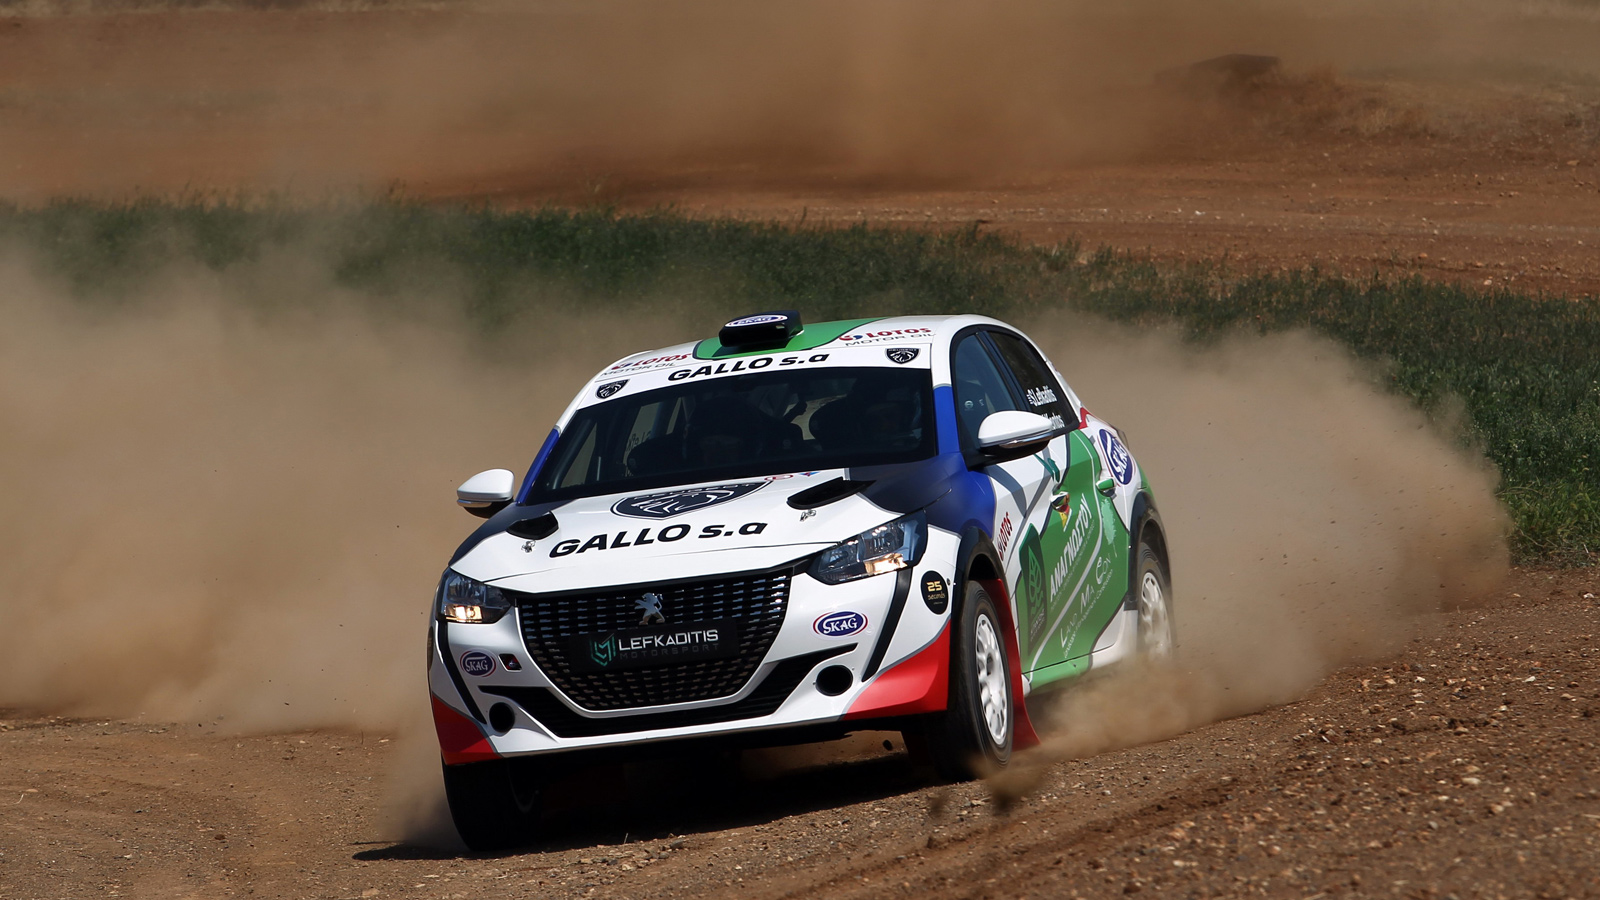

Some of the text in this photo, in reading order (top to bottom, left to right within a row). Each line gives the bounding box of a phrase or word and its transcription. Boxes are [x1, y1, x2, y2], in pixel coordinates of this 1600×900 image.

[845, 335, 905, 346] MOTOR
[866, 327, 931, 338] LOTOS
[632, 353, 693, 367] LOTOS
[668, 353, 830, 381] GALLO s.a
[1106, 431, 1129, 483] SKAG
[549, 521, 768, 557] GALLO s.a
[1049, 493, 1093, 602] ΑΝΑΓΝΩΣΤΟΥ
[926, 580, 943, 592] 25
[822, 613, 858, 634] SKAG
[618, 629, 719, 651] LEFKADITIS
[620, 643, 719, 660] MOTORSPORT
[465, 656, 489, 672] SKAG
